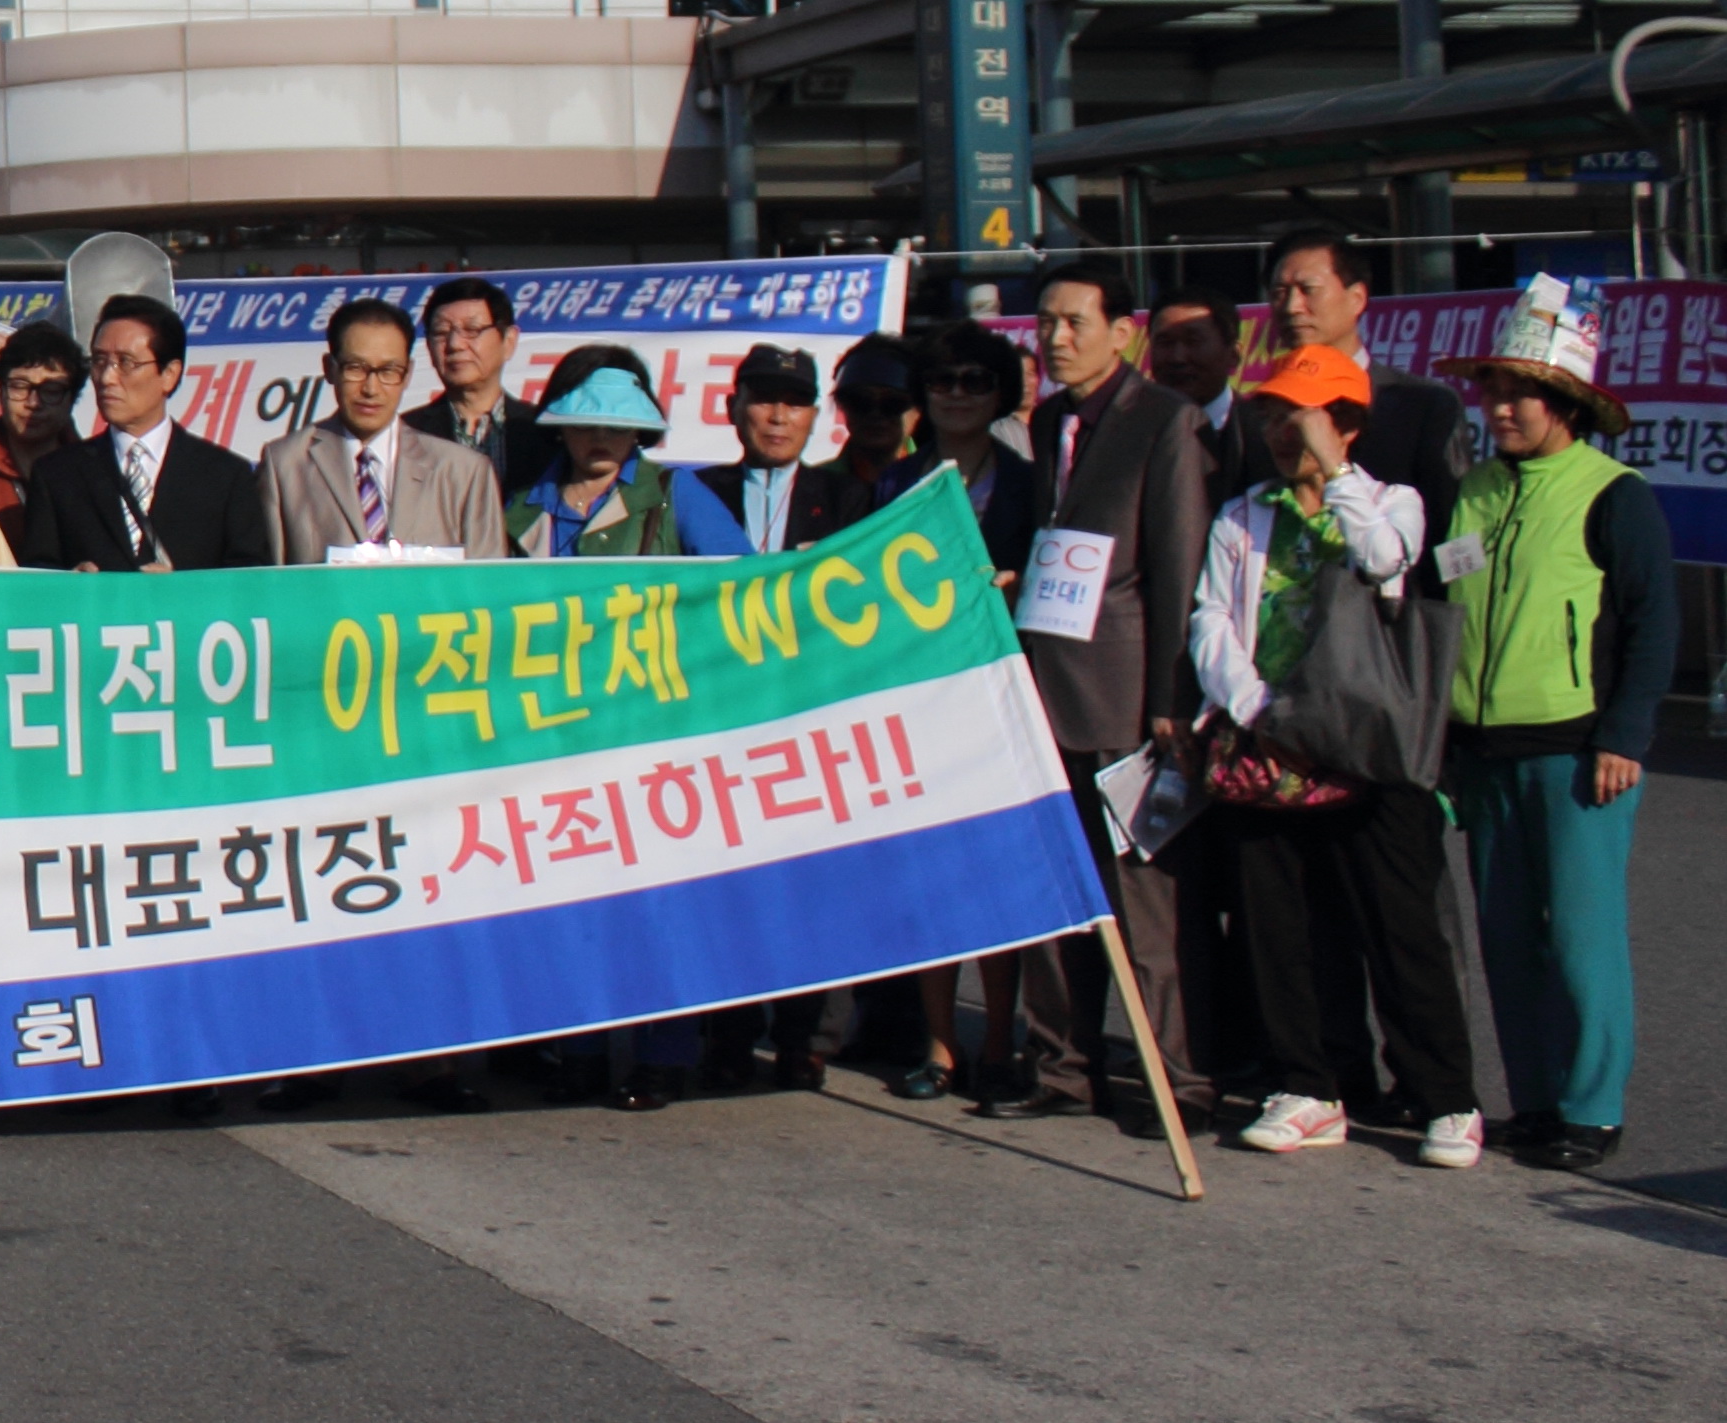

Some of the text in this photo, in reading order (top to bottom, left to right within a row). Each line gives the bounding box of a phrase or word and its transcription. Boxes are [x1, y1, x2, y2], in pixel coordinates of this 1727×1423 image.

[971, 0, 1010, 127] 대전역
[982, 206, 1014, 249] 4
[230, 291, 303, 330] WCC
[621, 274, 743, 321] 준비하는
[749, 268, 872, 323] 대표회장
[321, 582, 690, 757] 이적단체
[718, 531, 958, 669] WCC
